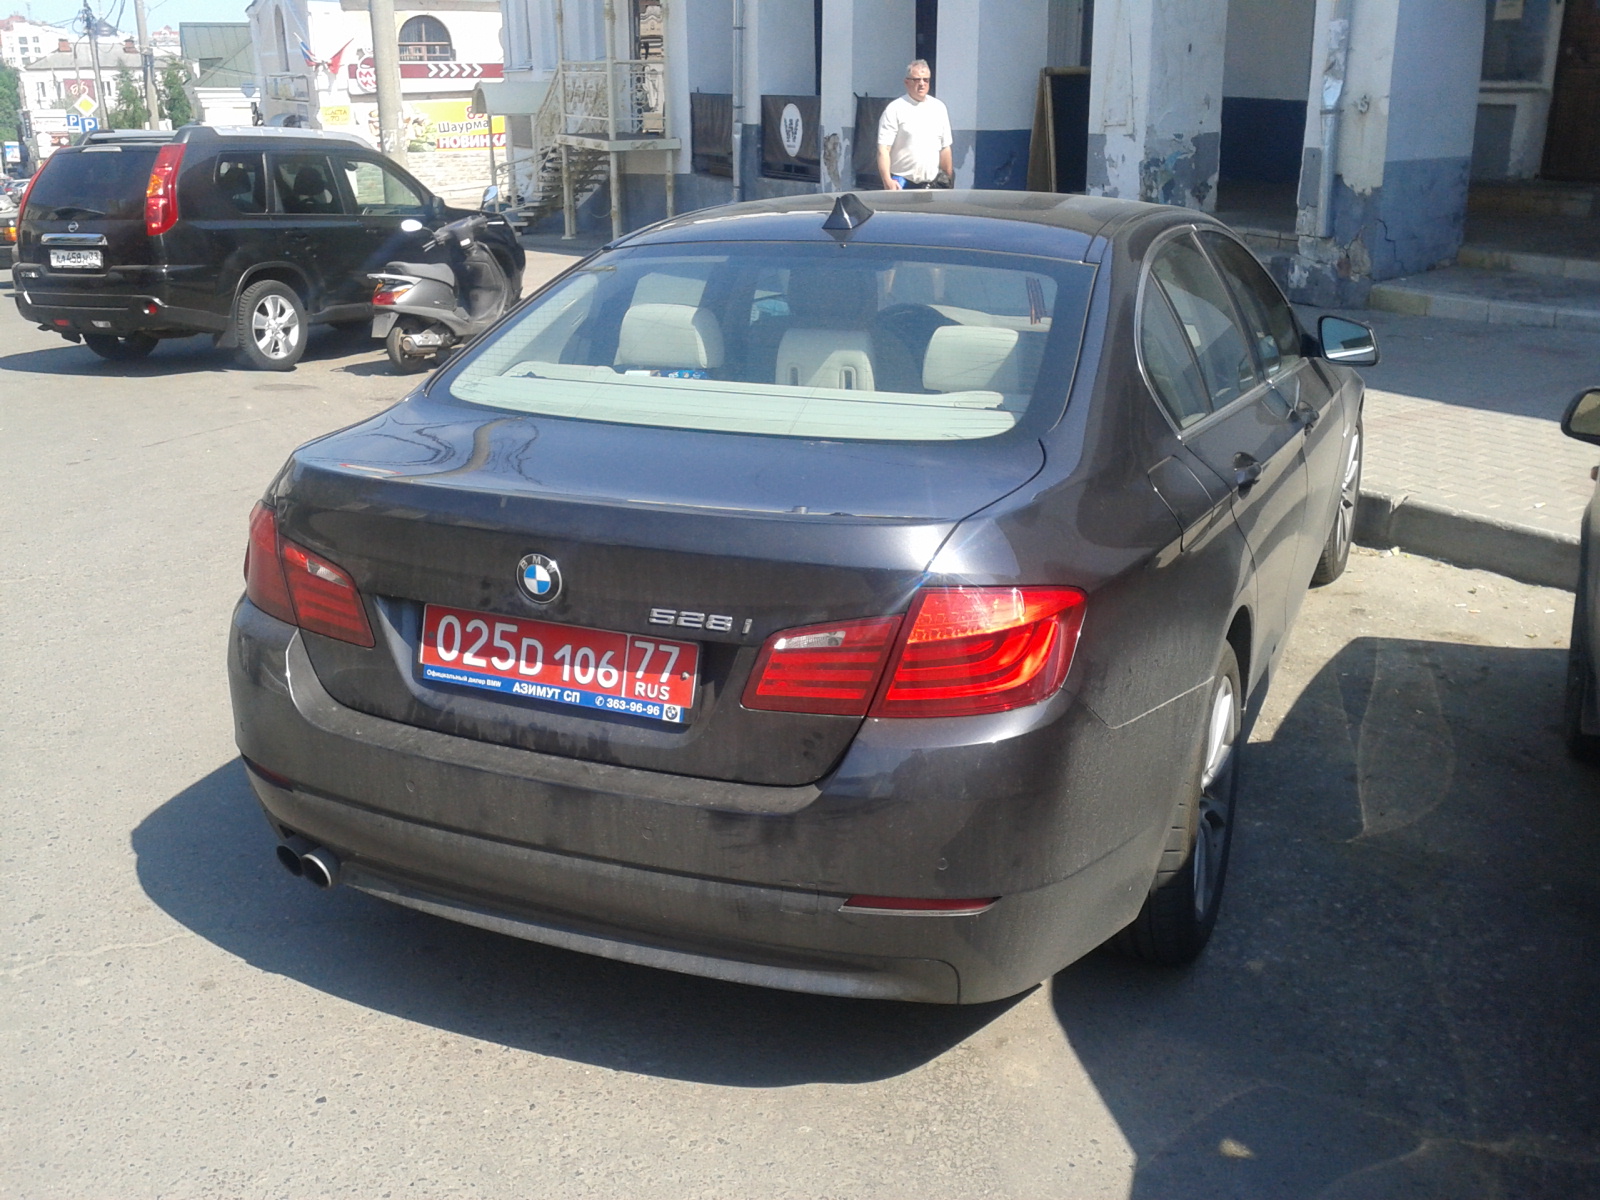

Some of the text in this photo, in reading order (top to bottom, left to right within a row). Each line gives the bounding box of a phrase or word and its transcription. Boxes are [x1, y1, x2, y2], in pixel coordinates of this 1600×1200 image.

[70, 115, 77, 126] P
[84, 118, 95, 132] P
[438, 119, 489, 133] Шаурма
[520, 555, 556, 574] BMW
[436, 614, 619, 689] 025D 106
[633, 641, 681, 684] 77
[486, 679, 502, 688] BMW
[512, 681, 580, 703] АЗИМУТ СП
[634, 681, 670, 700] RUS
[606, 698, 660, 716] 363-96-96
